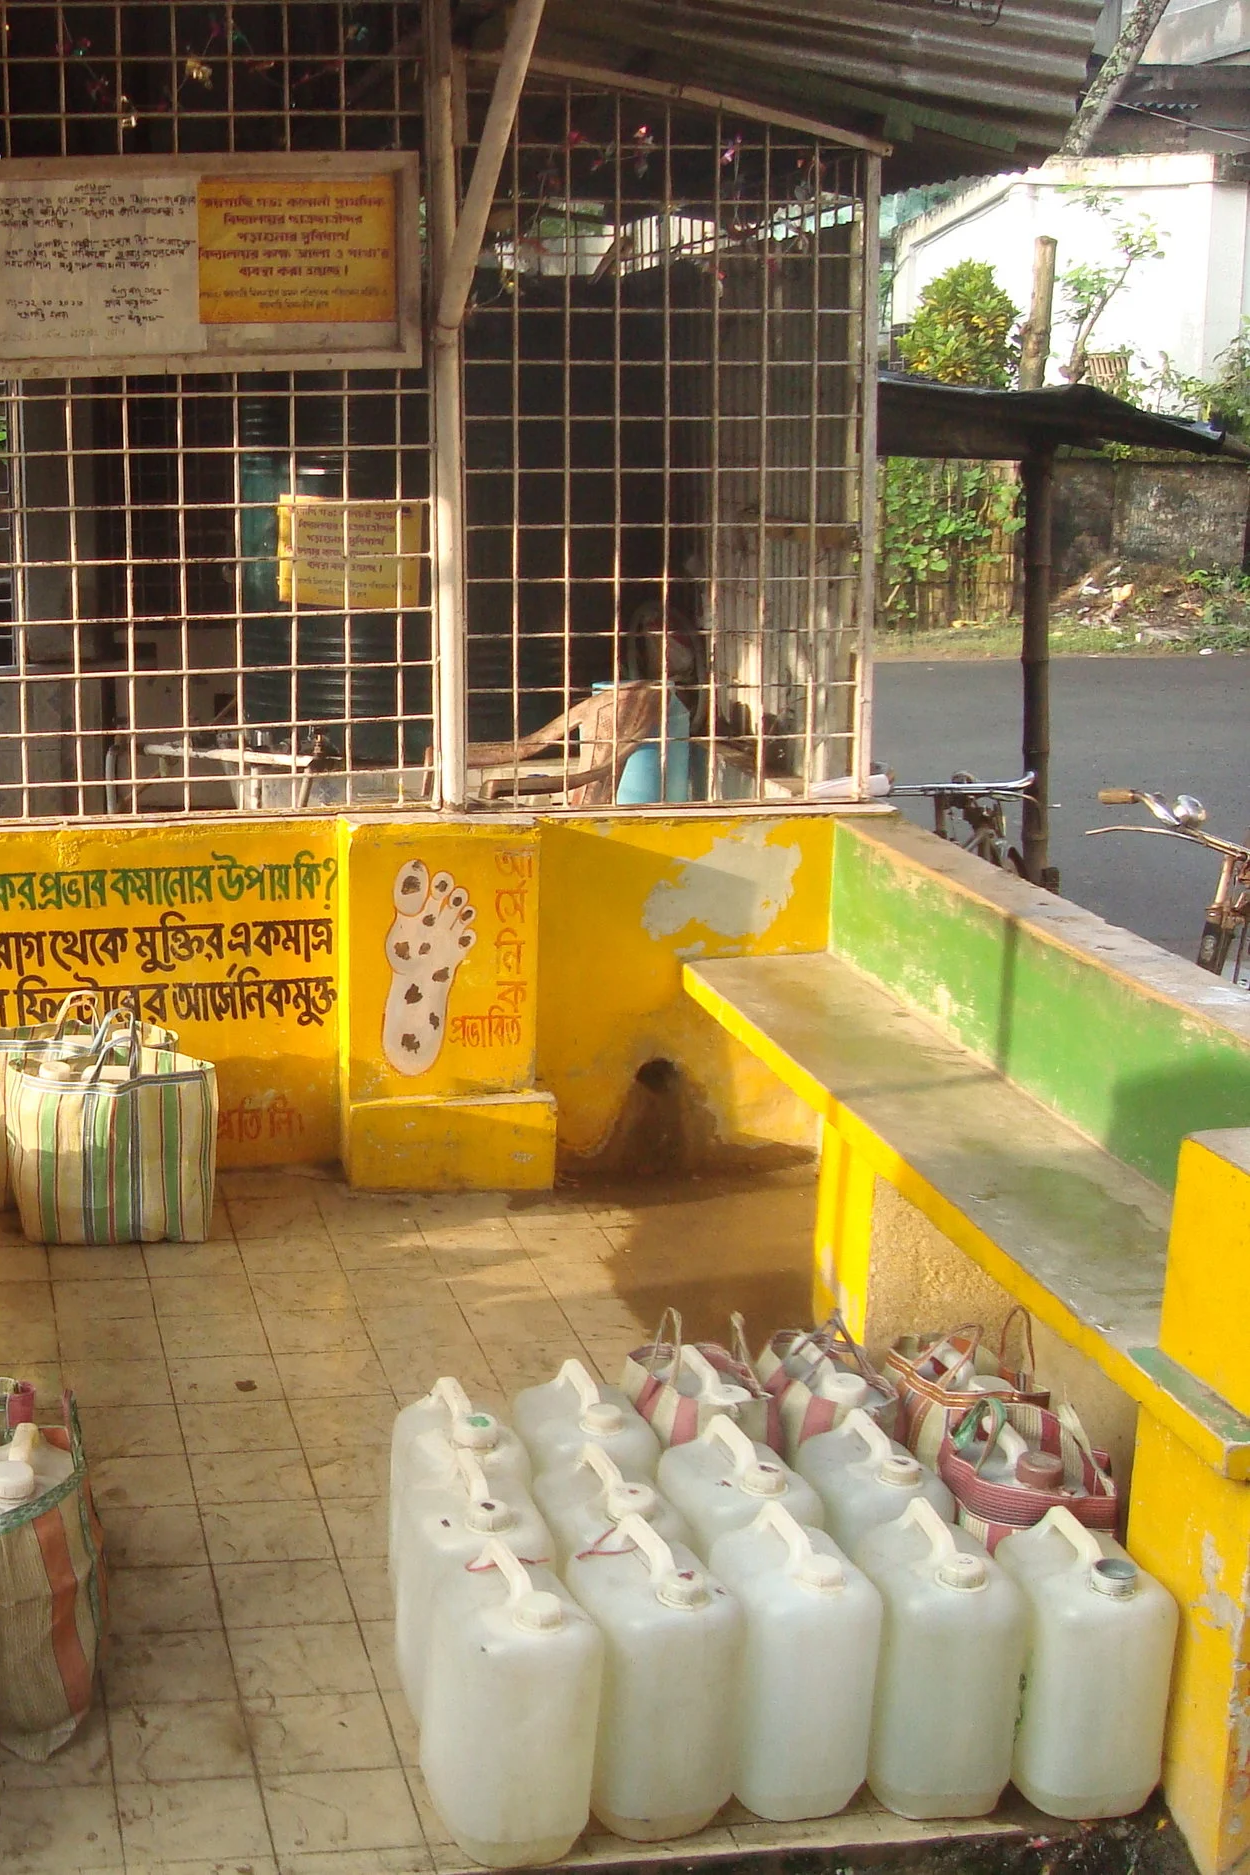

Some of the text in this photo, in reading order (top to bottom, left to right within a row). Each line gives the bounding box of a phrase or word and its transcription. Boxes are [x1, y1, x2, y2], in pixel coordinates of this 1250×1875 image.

[38, 869, 108, 911] প্রভাব
[110, 864, 216, 907] কমানোর
[211, 851, 292, 902] উপায়
[49, 927, 129, 972] থেকে
[134, 911, 225, 974] মুক্তির
